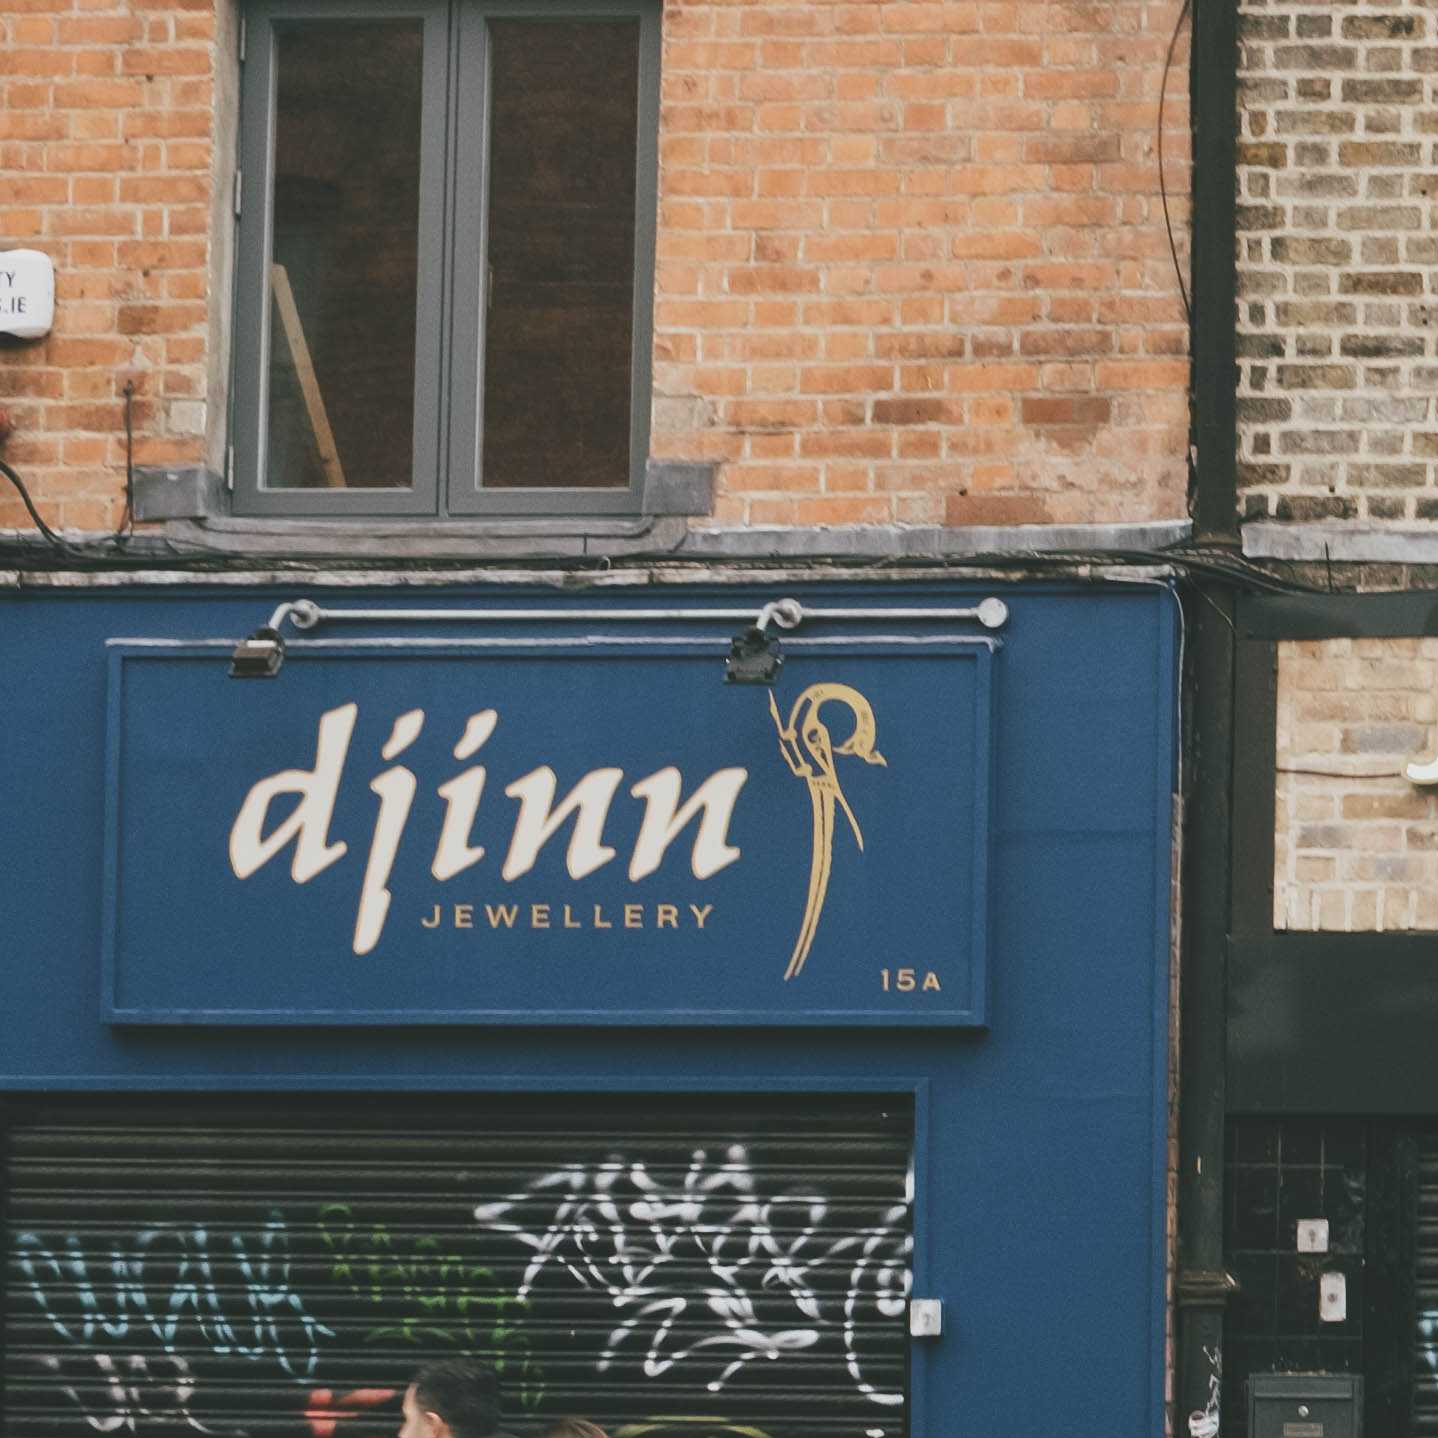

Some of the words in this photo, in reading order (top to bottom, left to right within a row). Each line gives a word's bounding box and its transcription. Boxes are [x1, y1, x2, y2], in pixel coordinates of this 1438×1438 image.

[229, 702, 748, 955] djinn
[422, 904, 713, 928] JEWELLERY
[880, 968, 941, 992] 15A
